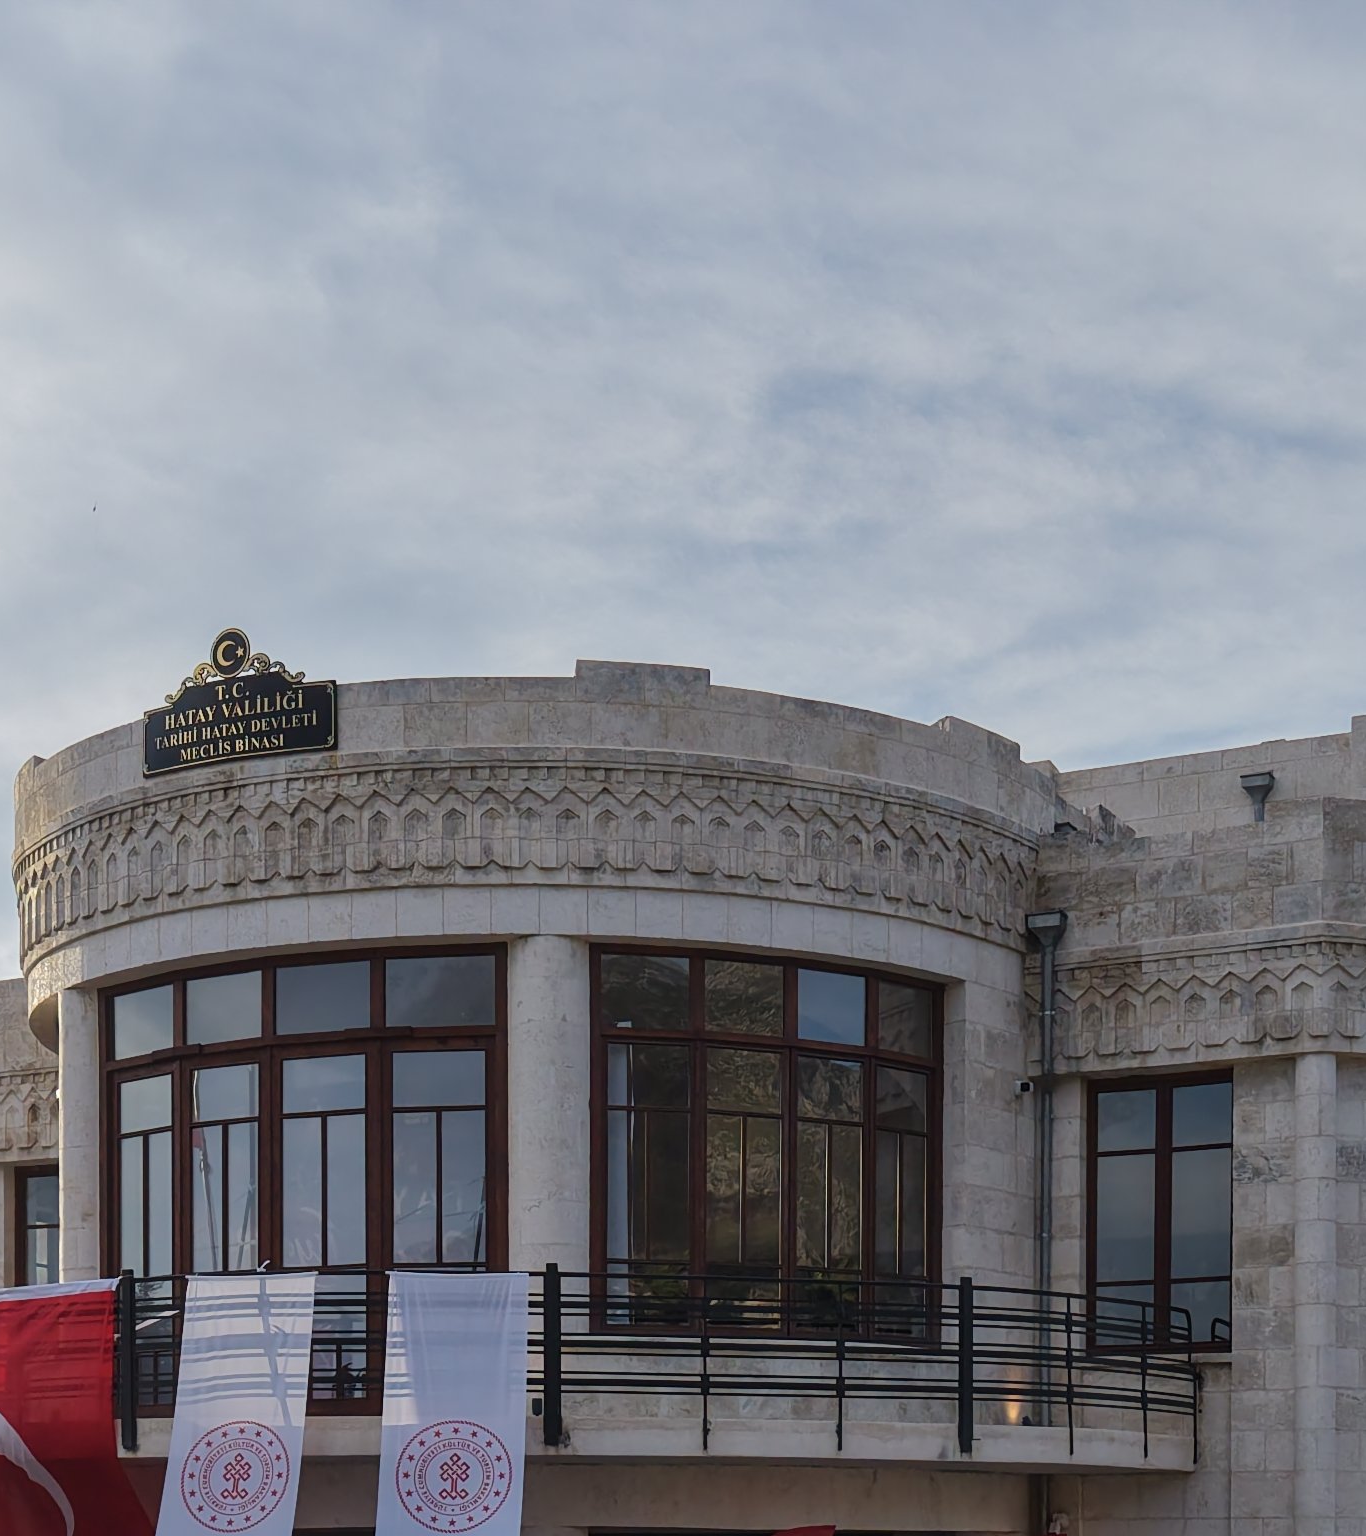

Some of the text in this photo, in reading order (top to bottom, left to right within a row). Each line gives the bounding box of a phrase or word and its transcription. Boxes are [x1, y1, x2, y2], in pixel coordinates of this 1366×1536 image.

[154, 709, 317, 750] TARİHİ HATAY DEVLETİ
[165, 690, 303, 730] HATAY VALİLİĞİ
[180, 734, 285, 762] MECLİS BİNASI
